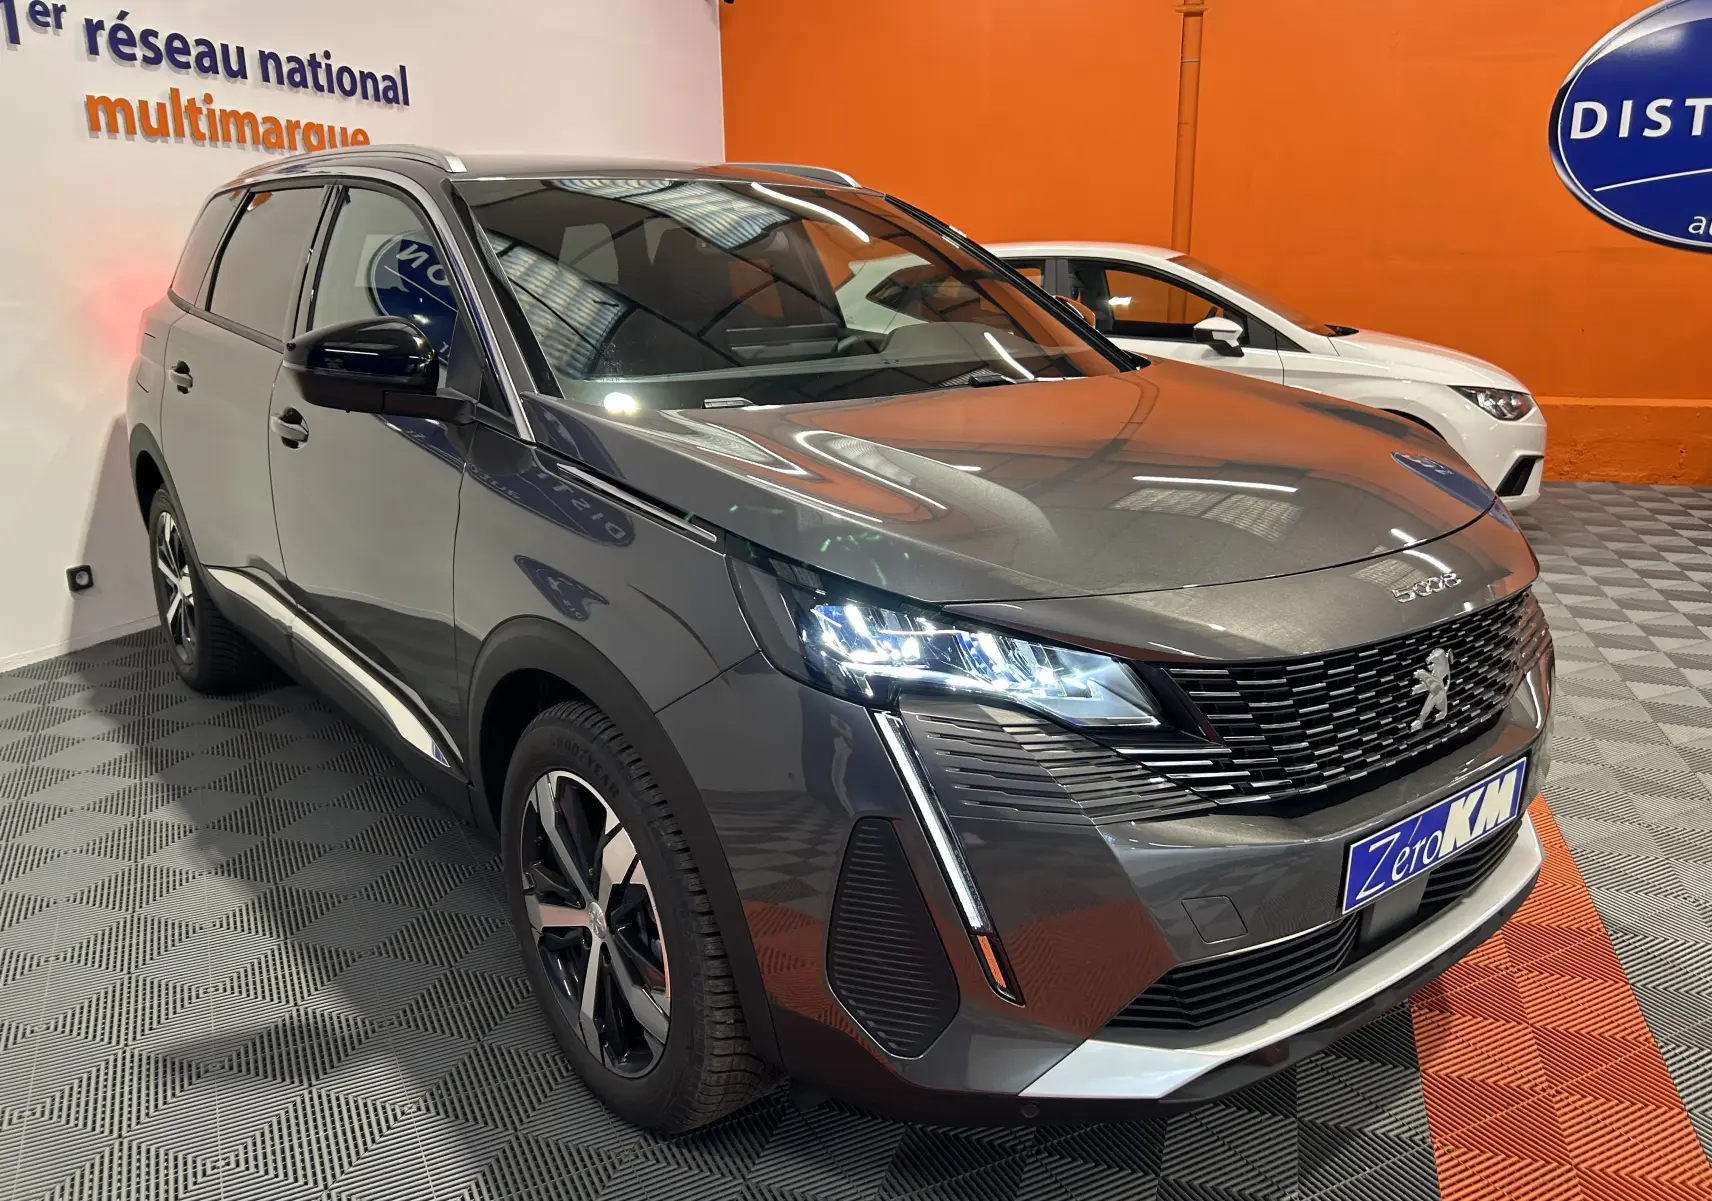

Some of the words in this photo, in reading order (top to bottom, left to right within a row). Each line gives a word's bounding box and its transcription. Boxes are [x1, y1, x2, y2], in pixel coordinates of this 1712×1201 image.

[84, 10, 248, 79] réseau
[257, 50, 411, 106] national
[85, 87, 371, 152] multimarque
[1570, 98, 1712, 139] DIST
[1391, 572, 1462, 603] 5008
